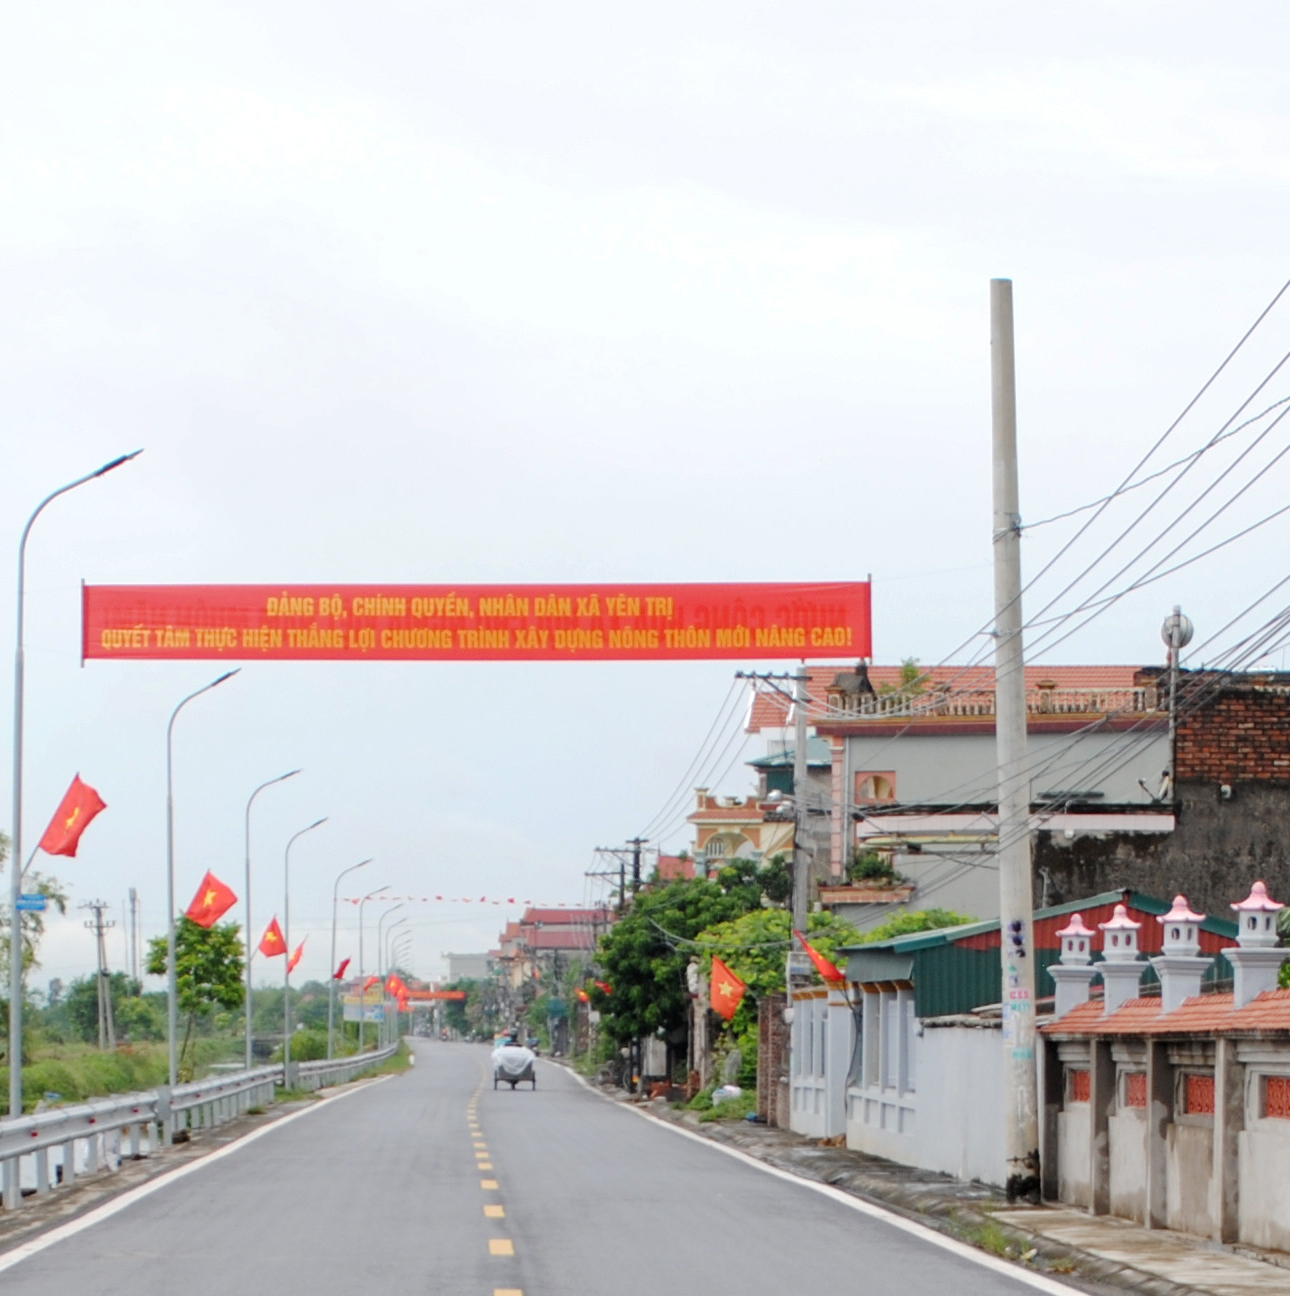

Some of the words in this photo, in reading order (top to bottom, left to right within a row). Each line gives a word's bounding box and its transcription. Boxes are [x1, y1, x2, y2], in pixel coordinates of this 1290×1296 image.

[267, 591, 314, 616] ĐẢNG
[319, 593, 348, 620] BỘ,
[353, 593, 406, 616] CHÍNH
[412, 591, 474, 618] QUYỀN,
[480, 594, 529, 616] NHÂN
[535, 594, 571, 616] DÂN
[577, 594, 601, 616] XÃ
[606, 593, 640, 616] YÊN
[646, 597, 674, 620] TRỊ
[102, 624, 151, 649] QUYẾT
[156, 625, 190, 647] TÂM
[195, 626, 237, 651] THỰC
[243, 625, 283, 651] HIỆN
[287, 622, 344, 647] THẮNG
[349, 628, 376, 652] LỢI
[381, 628, 452, 648] CHƯƠNG
[458, 625, 510, 648] TRÌNH
[516, 626, 549, 648] XÂY
[555, 628, 604, 652] DỰNG
[609, 626, 659, 648] NÔNG
[665, 625, 710, 647] THÔN
[716, 624, 750, 647] MỚI
[755, 624, 806, 647] NÂNG
[811, 627, 852, 646] CAO!
